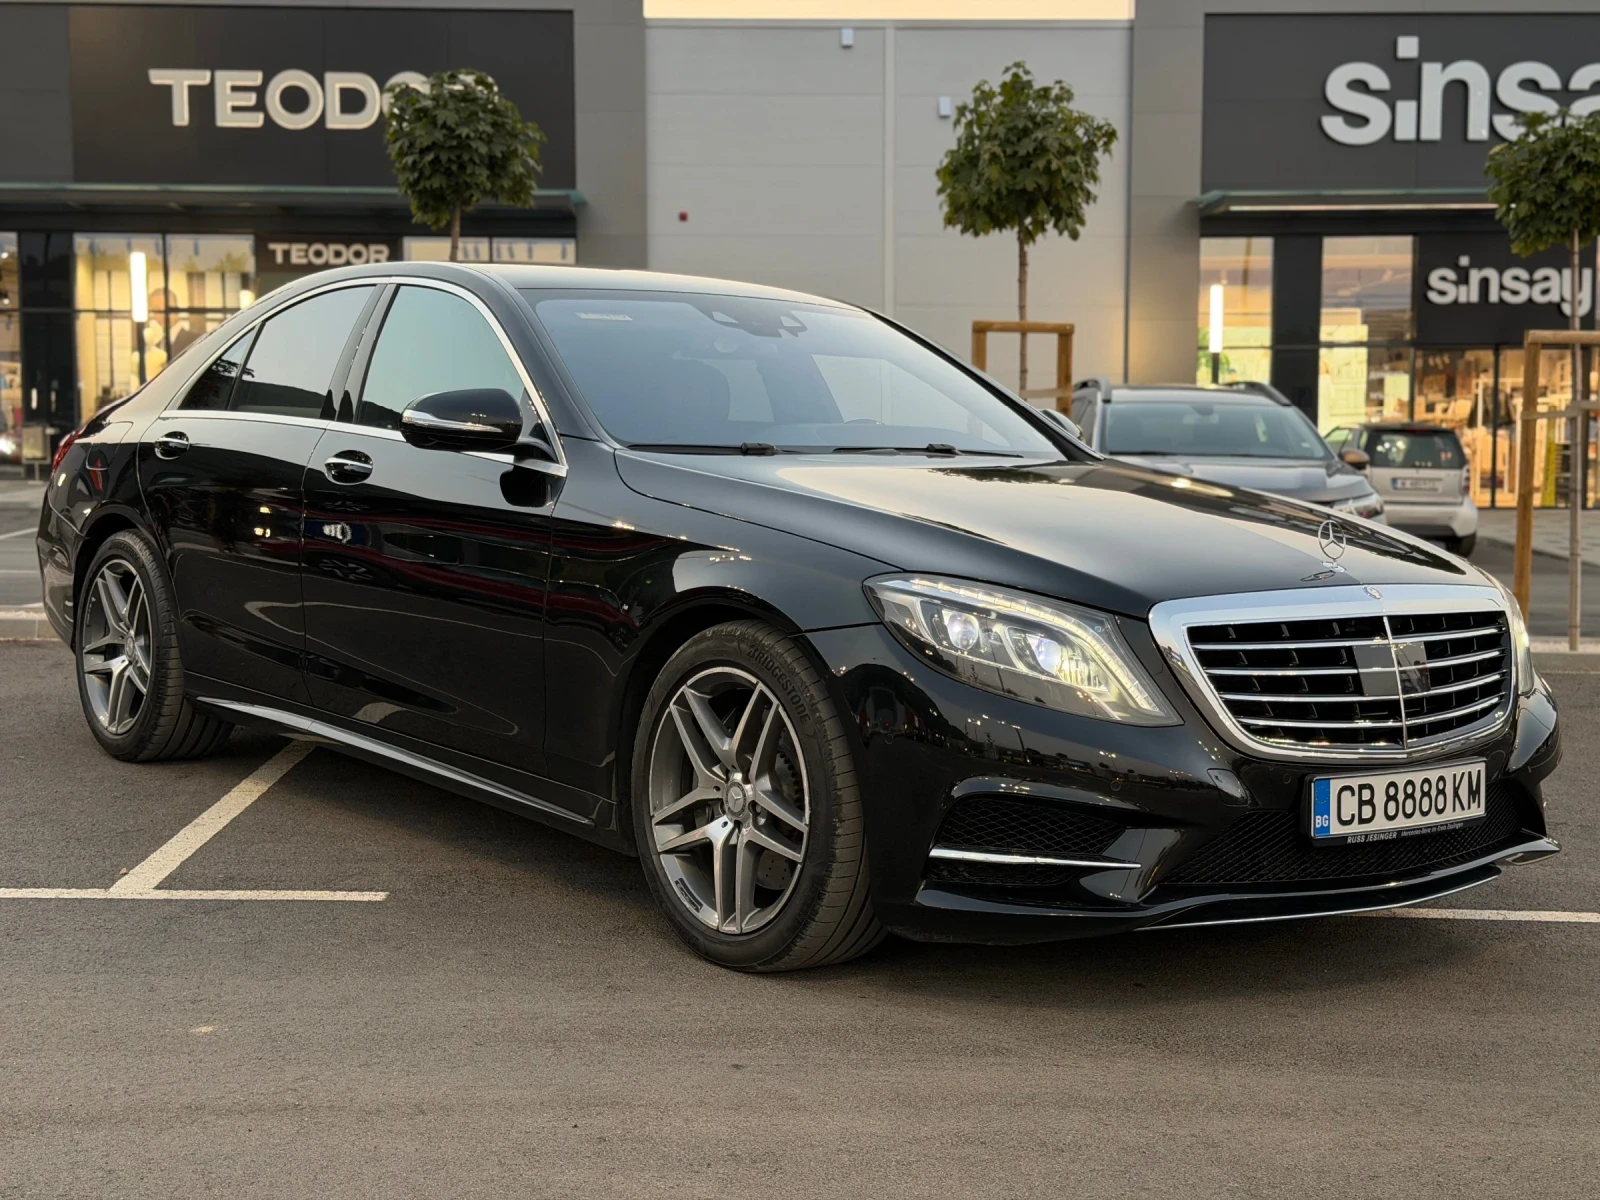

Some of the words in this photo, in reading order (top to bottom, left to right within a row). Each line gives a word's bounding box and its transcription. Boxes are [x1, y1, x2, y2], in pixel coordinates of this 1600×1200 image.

[267, 242, 391, 266] TEODOR
[1427, 255, 1592, 318] sinsay
[746, 645, 811, 725] BRIDGESTONE
[1336, 783, 1376, 826] CB
[1383, 775, 1447, 821] 8888
[1452, 769, 1481, 813] KM
[1315, 814, 1329, 828] BG
[1347, 835, 1365, 844] RUSS
[1366, 832, 1397, 842] JESINGER
